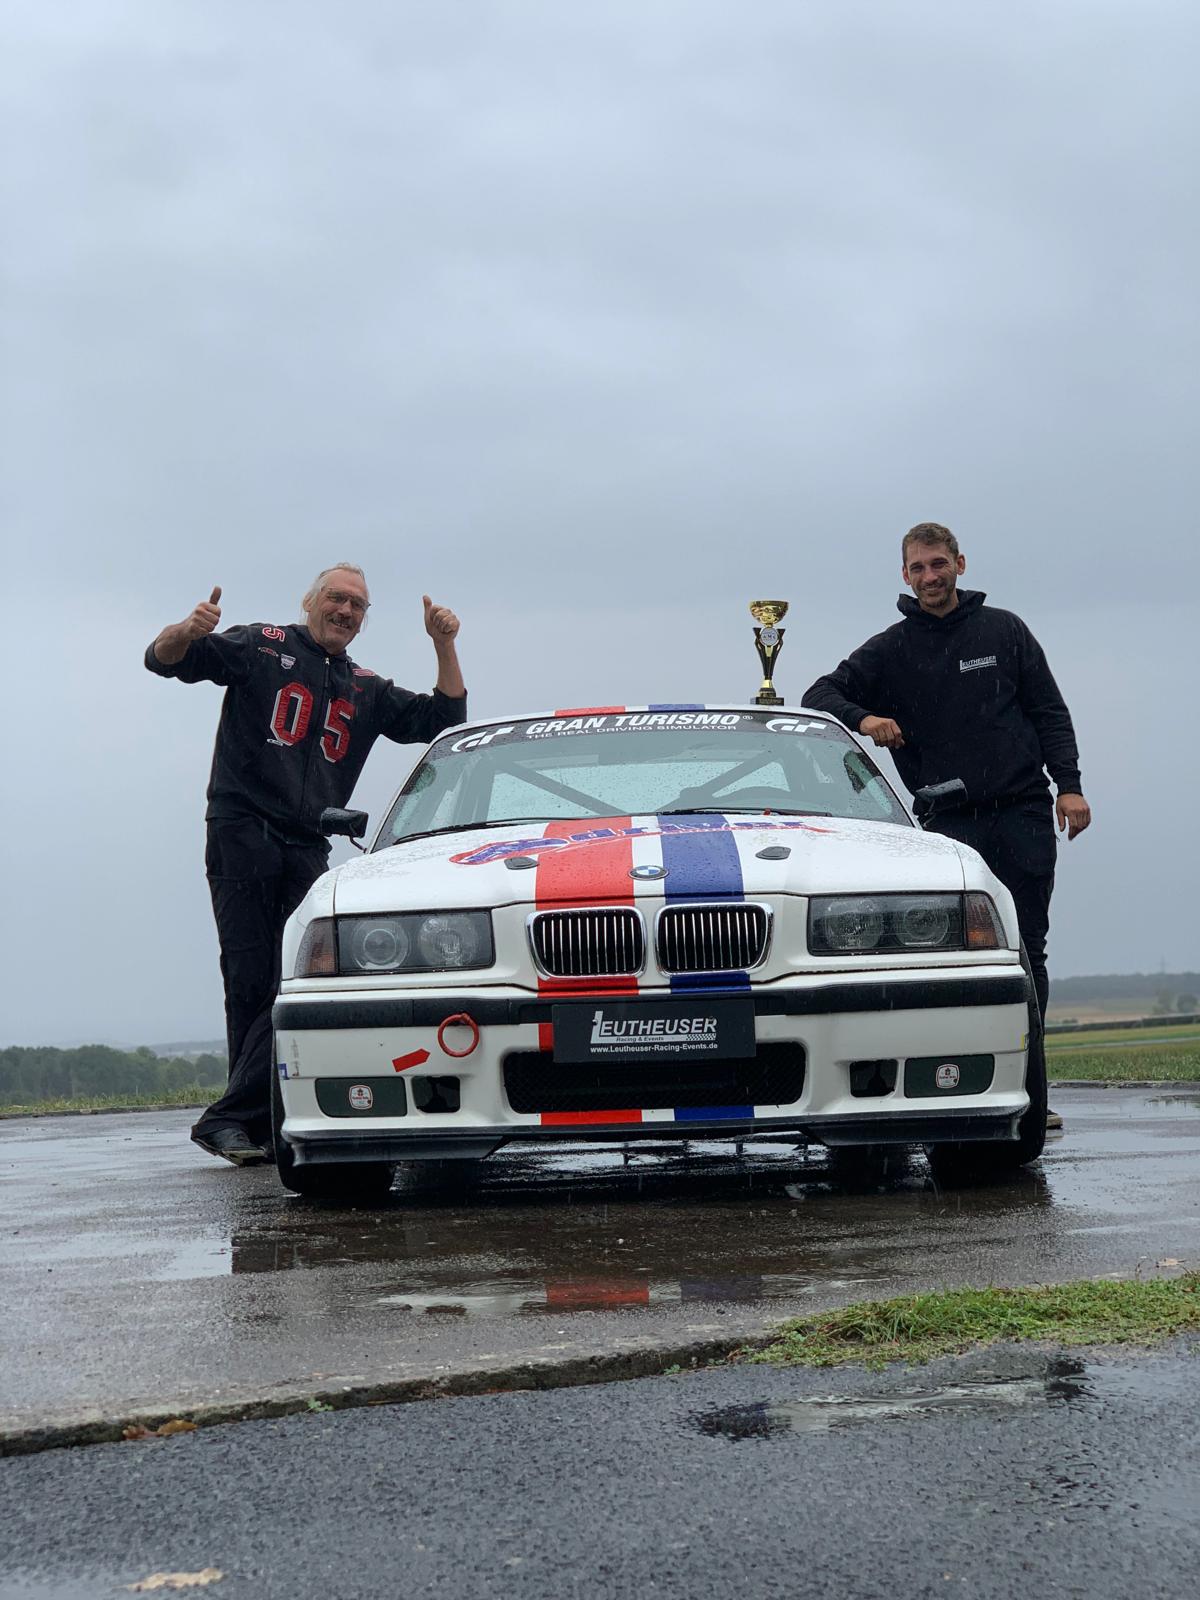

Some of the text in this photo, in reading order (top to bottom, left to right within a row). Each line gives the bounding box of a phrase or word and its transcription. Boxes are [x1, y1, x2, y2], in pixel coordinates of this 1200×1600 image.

[526, 714, 740, 735] GRAN TURISMO
[591, 1010, 718, 1044] LEUTHEUSER
[590, 1043, 718, 1053] www.Leutheuser-Racing-Events.de
